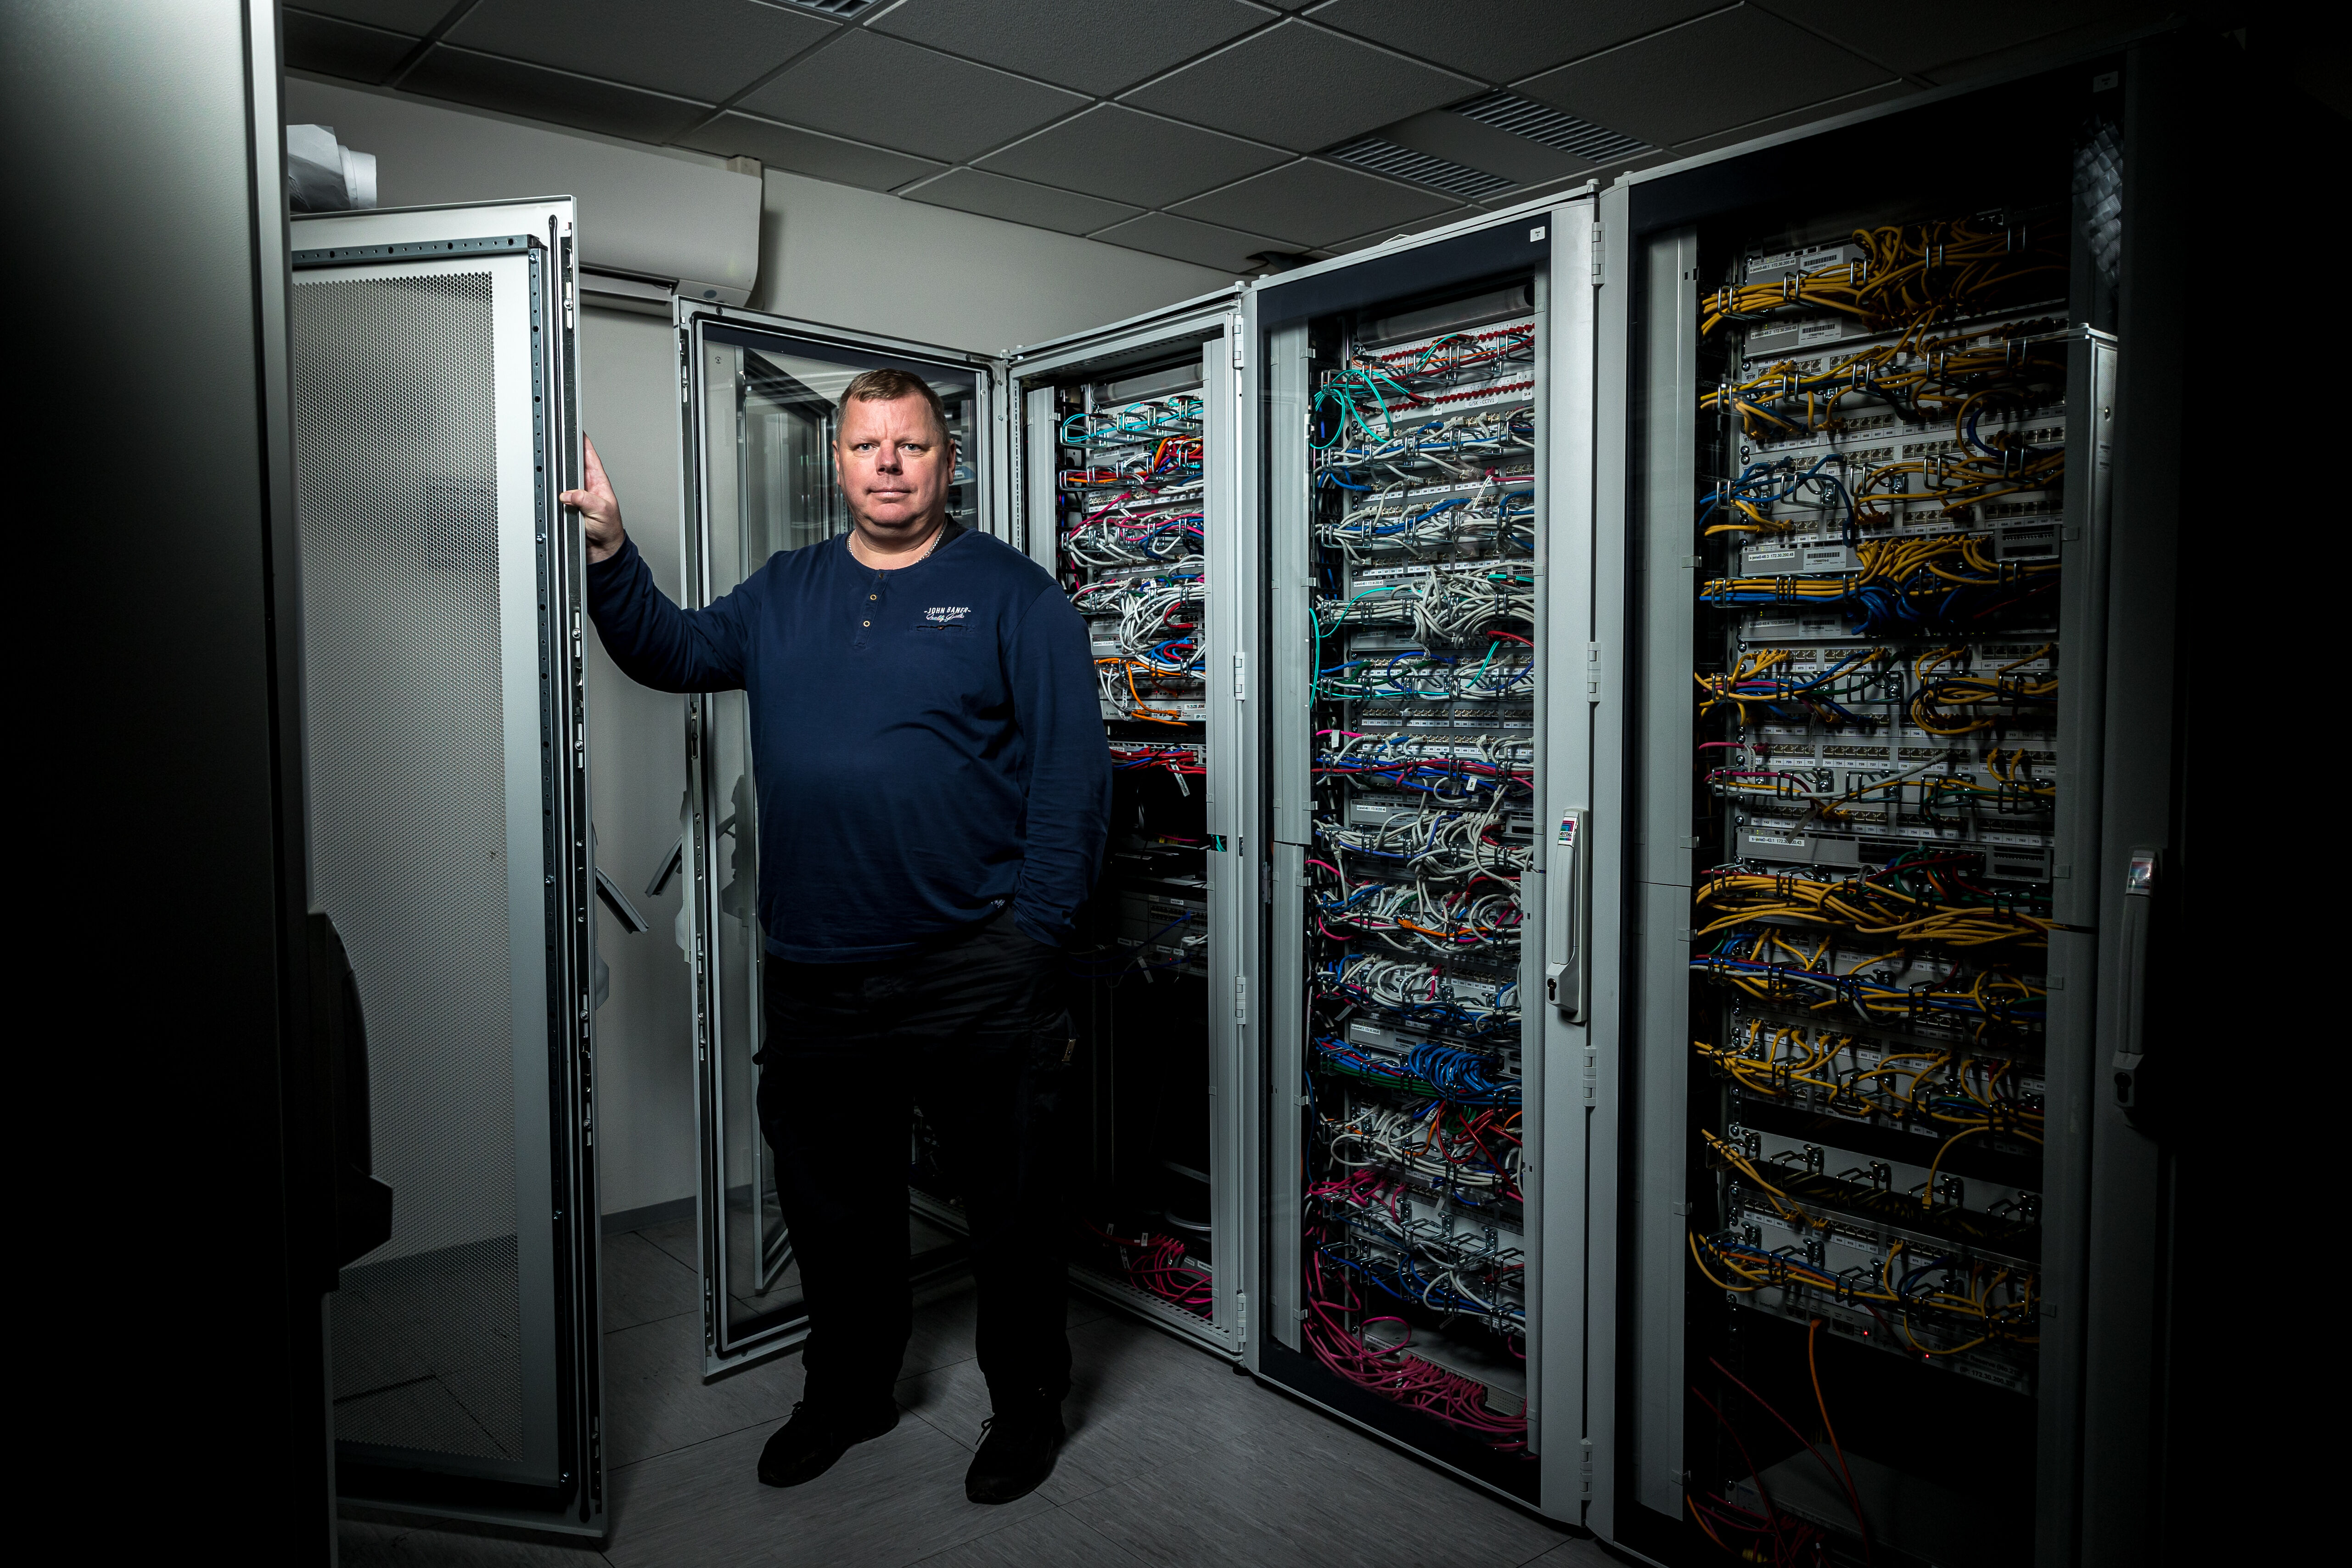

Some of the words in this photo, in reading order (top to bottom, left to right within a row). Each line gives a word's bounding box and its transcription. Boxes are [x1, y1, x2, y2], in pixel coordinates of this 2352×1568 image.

[1759, 1301, 1778, 1310] interflex
[1970, 1355, 1995, 1367] Reserve
[1972, 1370, 2015, 1388] 172.30.200.33)
